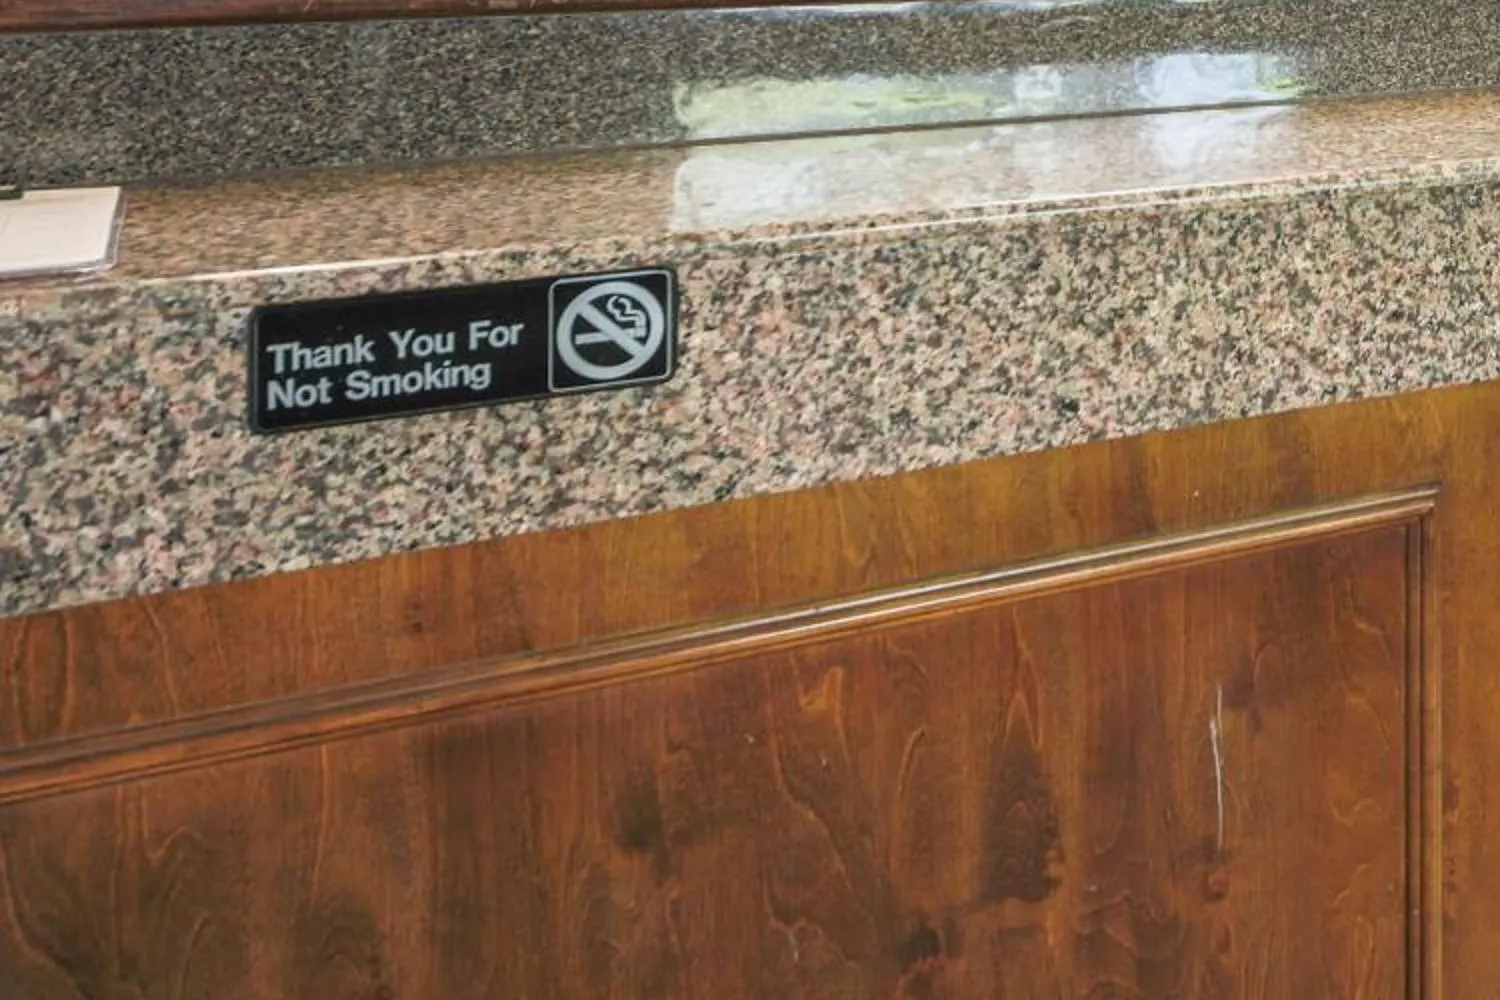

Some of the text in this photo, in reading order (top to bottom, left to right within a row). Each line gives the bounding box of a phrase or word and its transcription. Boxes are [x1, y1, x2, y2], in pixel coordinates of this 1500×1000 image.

[267, 321, 523, 374] Thank You For
[267, 361, 491, 411] Not Smoking
